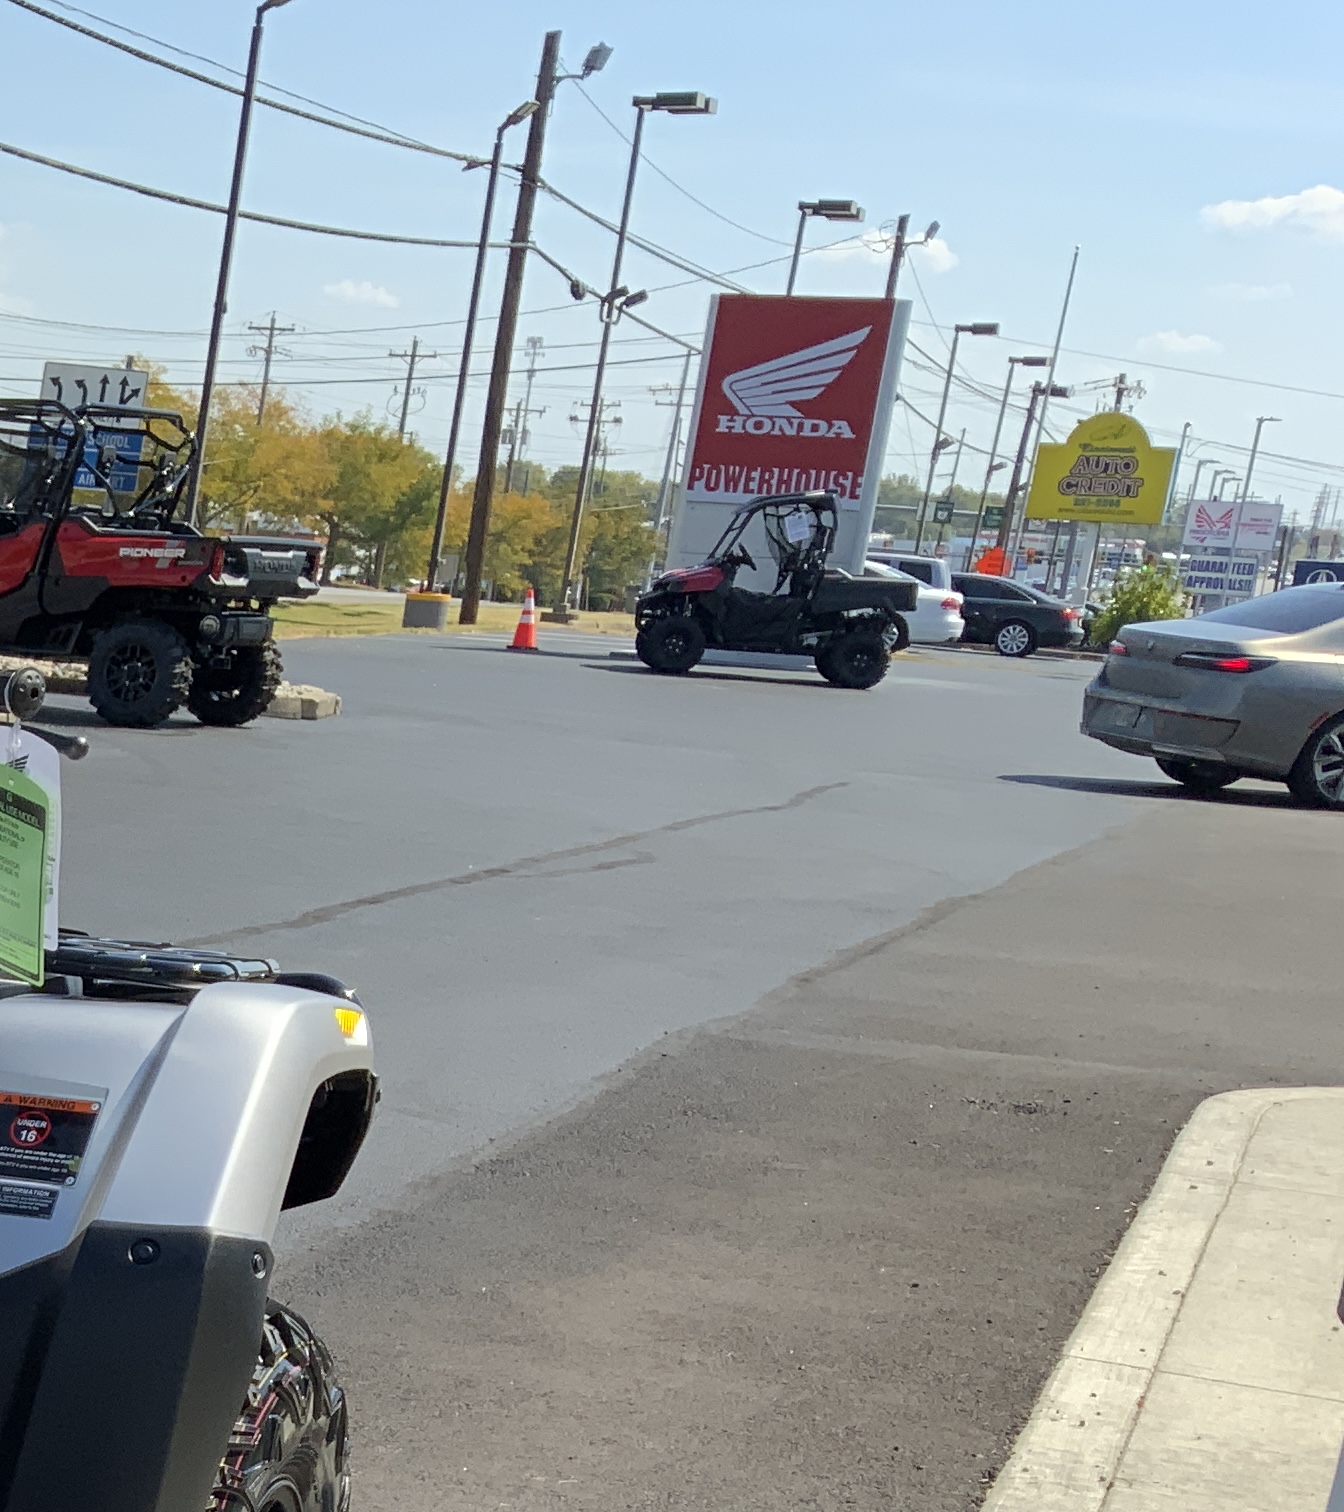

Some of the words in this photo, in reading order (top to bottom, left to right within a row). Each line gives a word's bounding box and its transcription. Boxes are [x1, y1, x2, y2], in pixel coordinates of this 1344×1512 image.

[715, 415, 856, 439] HONDA
[1070, 454, 1138, 476] AUTO
[687, 464, 862, 500] POWERHOUSE
[1058, 476, 1144, 498] CREDIT
[119, 548, 186, 558] PIONEER
[18, 810, 42, 828] MODEL
[18, 1095, 76, 1110] WARNING
[17, 1118, 48, 1129] UNDER
[19, 1129, 38, 1143] 16
